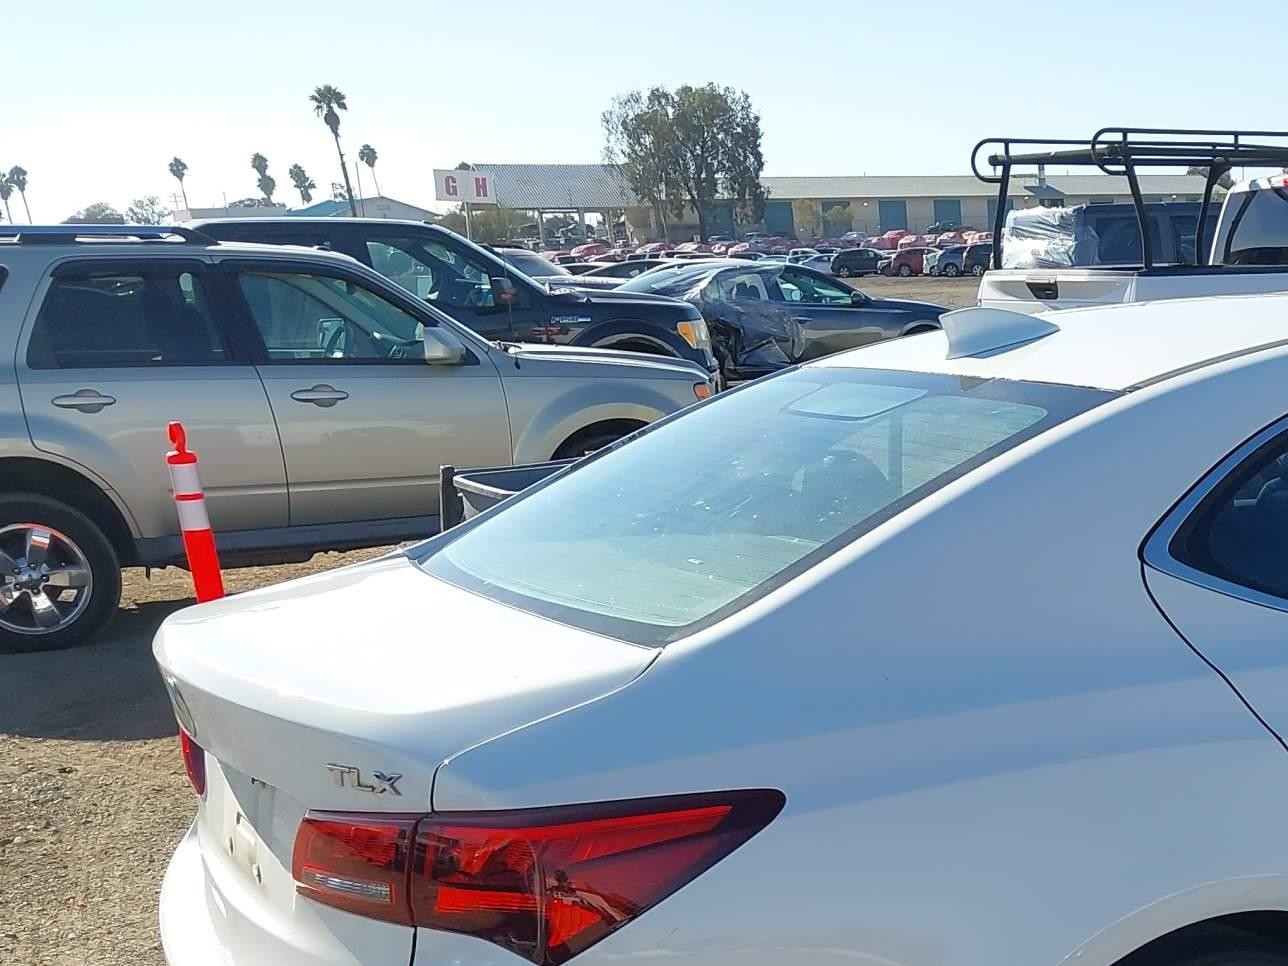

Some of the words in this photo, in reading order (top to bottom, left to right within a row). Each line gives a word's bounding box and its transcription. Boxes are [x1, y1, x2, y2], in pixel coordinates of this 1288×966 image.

[444, 175, 458, 197] G
[474, 177, 488, 198] H
[326, 763, 402, 796] TLX
